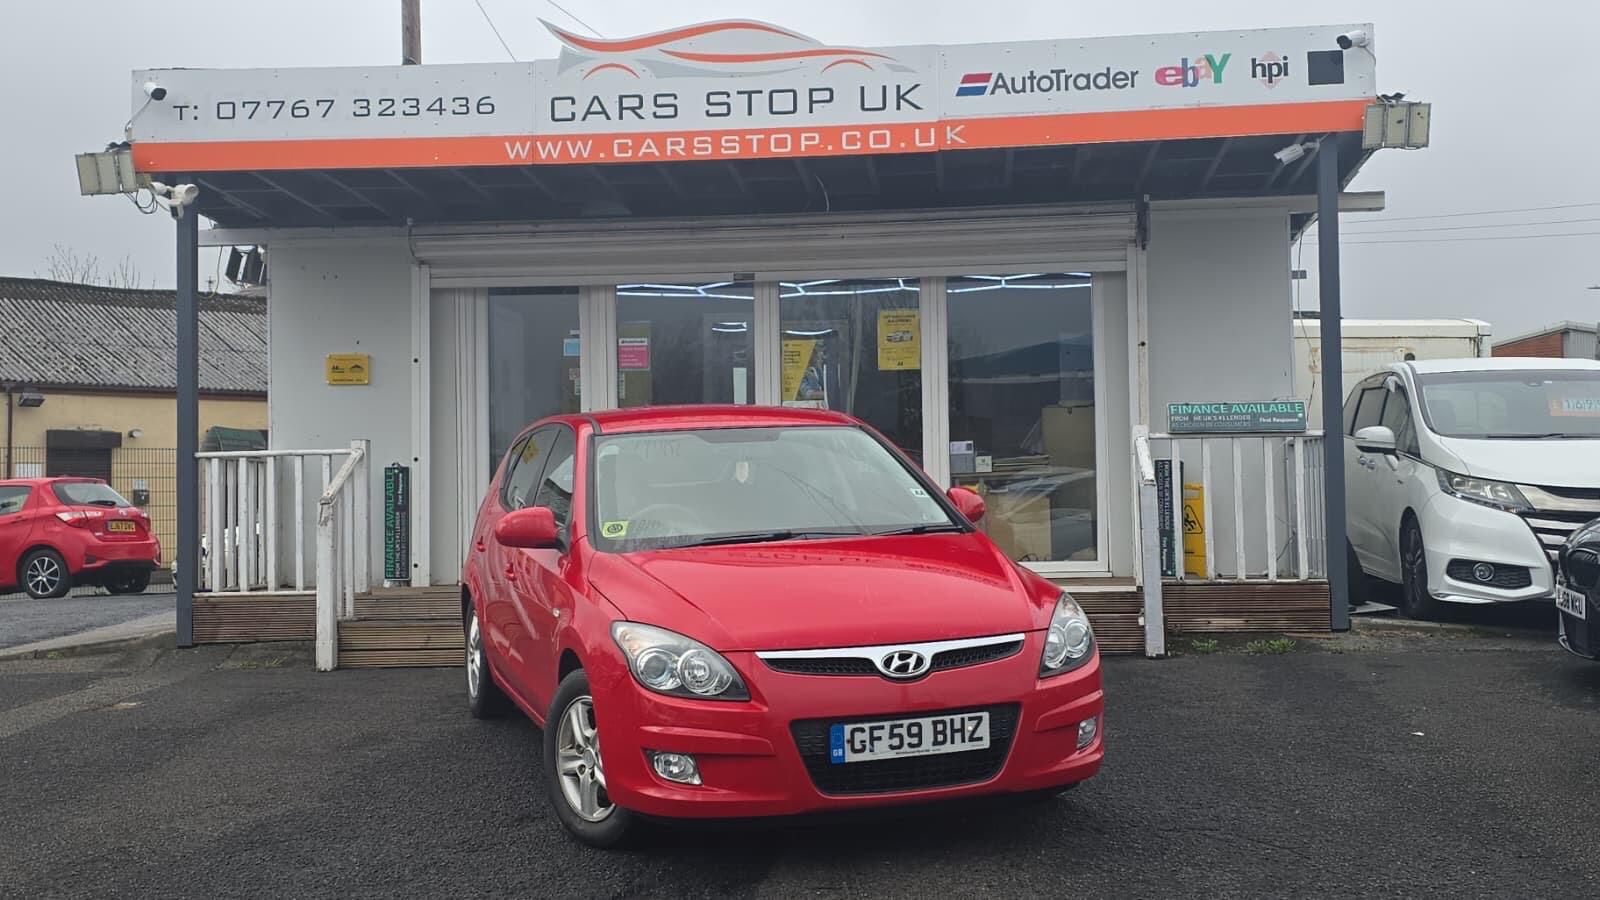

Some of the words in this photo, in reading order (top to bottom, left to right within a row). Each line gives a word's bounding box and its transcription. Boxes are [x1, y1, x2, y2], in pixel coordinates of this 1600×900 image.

[990, 66, 1139, 95] AutoTrader
[1250, 55, 1289, 84] hpi
[172, 104, 200, 121] T:
[216, 98, 336, 121] 07767
[352, 95, 497, 117] 323436
[549, 91, 679, 122] CARS
[705, 86, 835, 118] STOP
[859, 83, 924, 113] UK
[504, 124, 966, 159] WWW.CARSSTOP.CO.UK
[1170, 404, 1228, 415] FINANCE
[1231, 403, 1303, 414] AVAILABLE
[385, 468, 394, 528] AVAILABLE
[385, 530, 394, 578] FINANCE
[849, 722, 922, 754] GF59
[931, 715, 983, 747] BHZ
